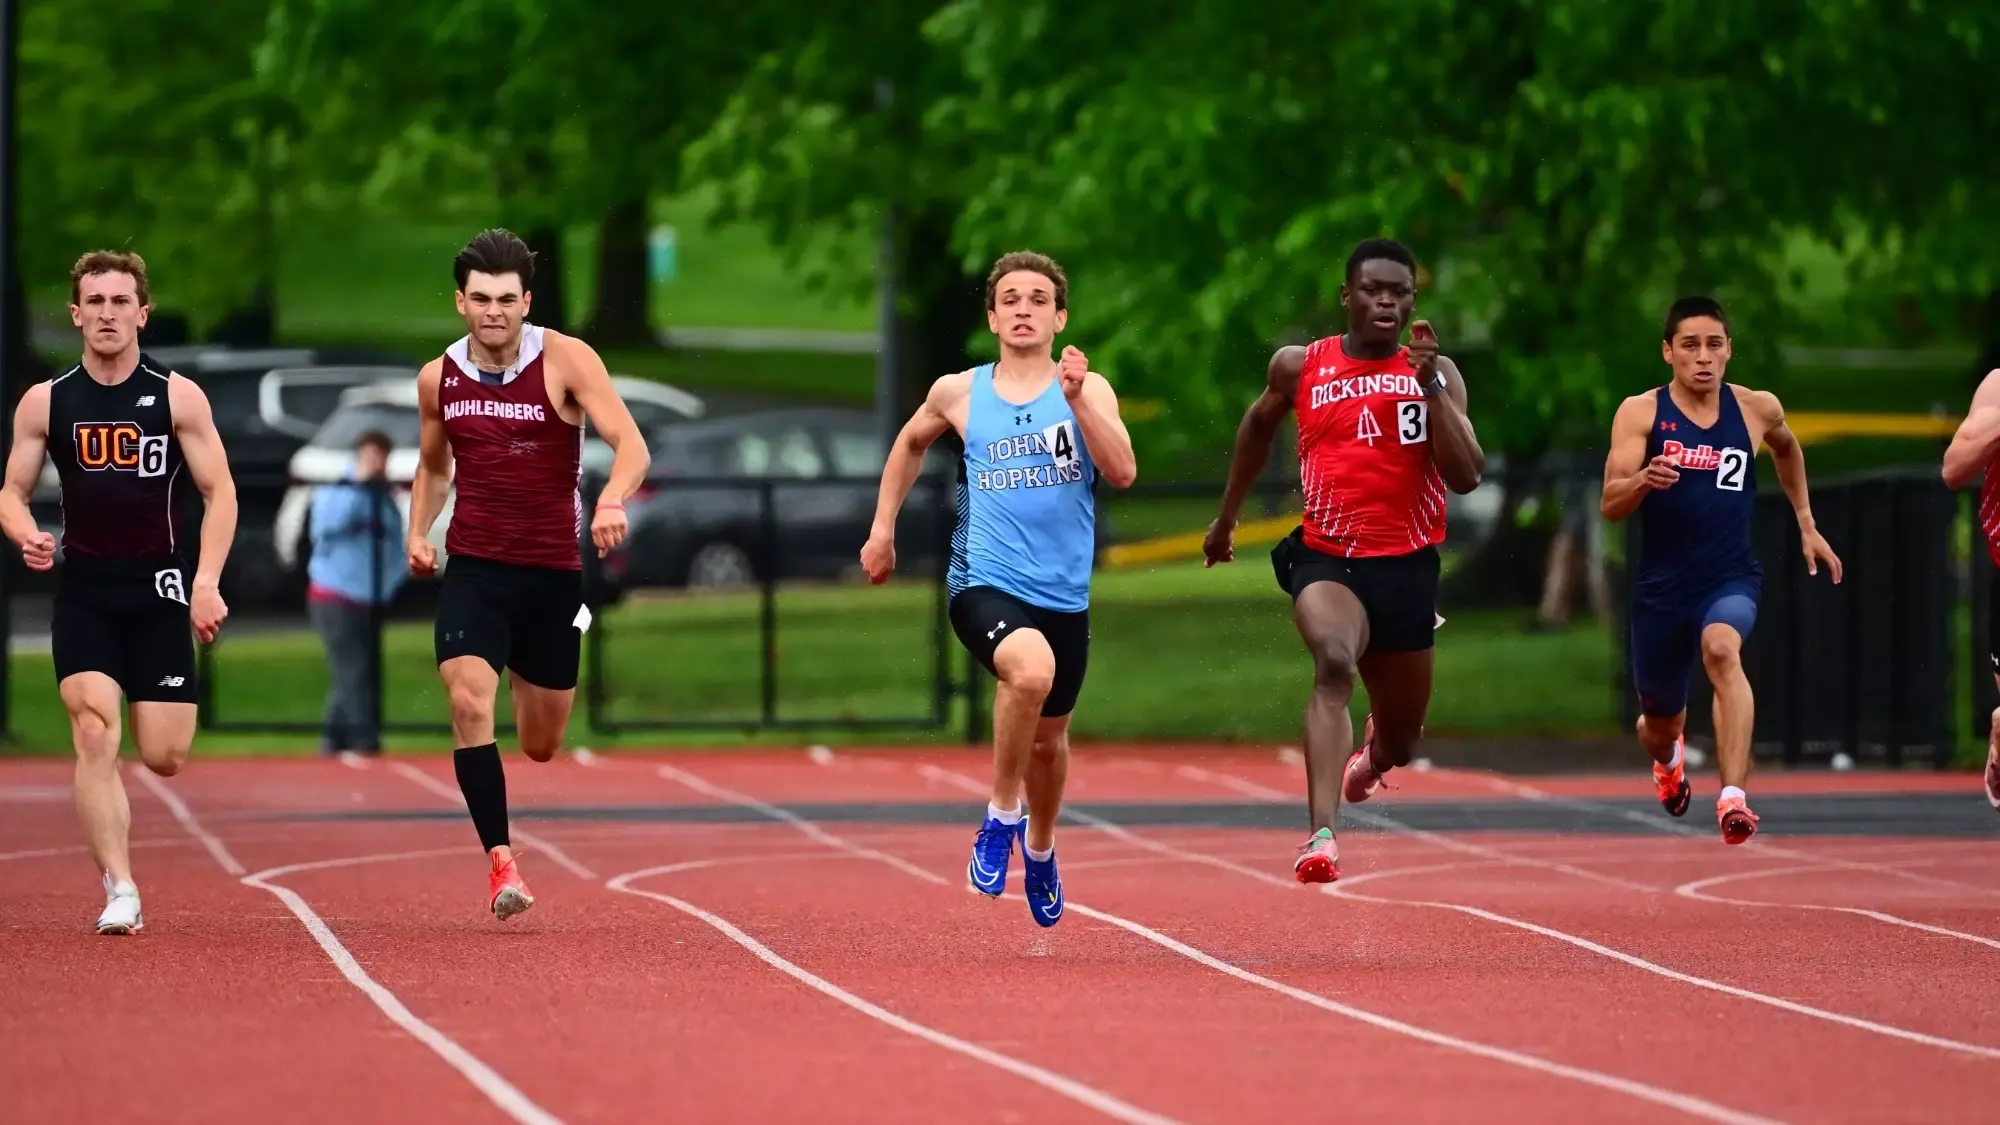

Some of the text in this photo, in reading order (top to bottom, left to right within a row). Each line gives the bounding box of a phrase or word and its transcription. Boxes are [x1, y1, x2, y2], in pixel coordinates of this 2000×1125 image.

[1311, 373, 1424, 410] DICKINSON
[444, 399, 546, 422] MUHLENBERG
[1402, 403, 1422, 441] 3
[74, 421, 144, 471] UC
[142, 438, 163, 474] 6
[987, 432, 1053, 465] JOHN
[1054, 424, 1073, 461] 4
[977, 460, 1082, 491] HOPKINS
[1720, 453, 1742, 488] 2
[159, 571, 181, 601] 6
